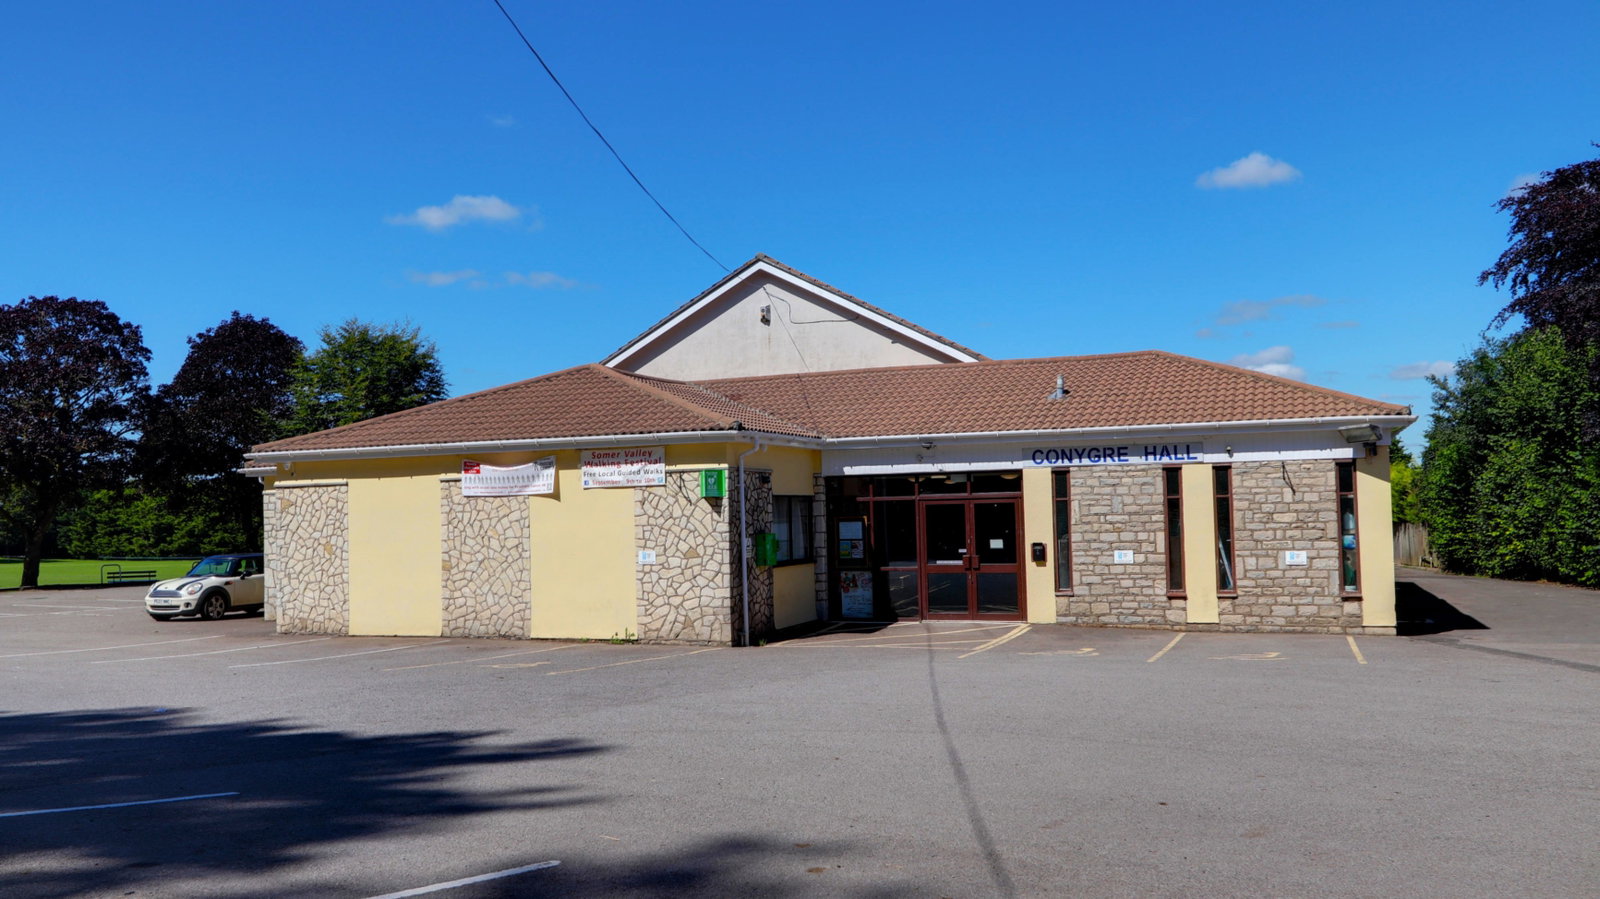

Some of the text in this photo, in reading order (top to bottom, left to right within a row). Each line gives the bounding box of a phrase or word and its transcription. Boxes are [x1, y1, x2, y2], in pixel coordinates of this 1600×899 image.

[591, 449, 653, 460] Somer Valley
[1032, 444, 1198, 465] CONYGRE HALL
[584, 456, 662, 469] Walking Festival
[643, 467, 663, 475] Walks
